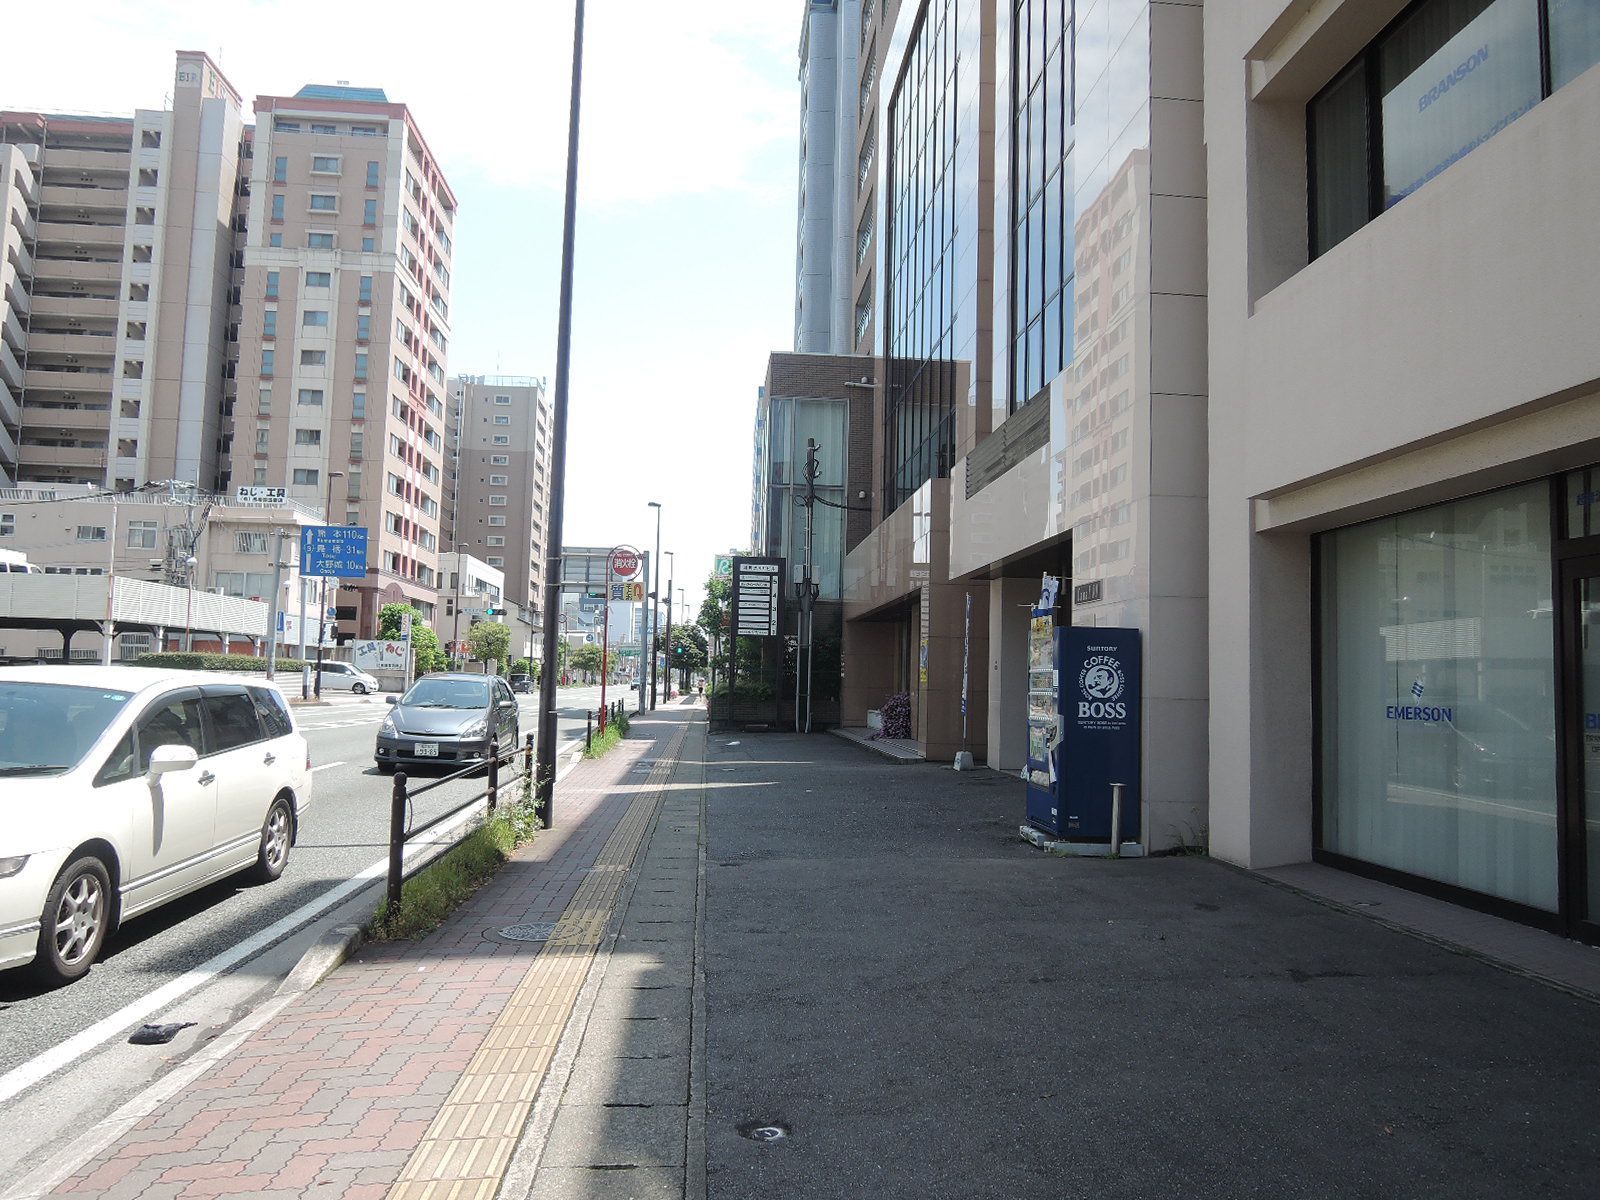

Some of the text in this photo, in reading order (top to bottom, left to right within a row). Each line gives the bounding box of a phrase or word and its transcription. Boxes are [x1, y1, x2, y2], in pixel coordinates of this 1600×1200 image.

[1418, 44, 1488, 113] BRANSON
[239, 488, 285, 498] ねじ・工具
[614, 558, 637, 569] 消火栓
[611, 584, 625, 601] 質
[1083, 655, 1121, 670] COFFEE
[1078, 701, 1127, 719] BOSS
[1386, 705, 1453, 722] EMERSON
